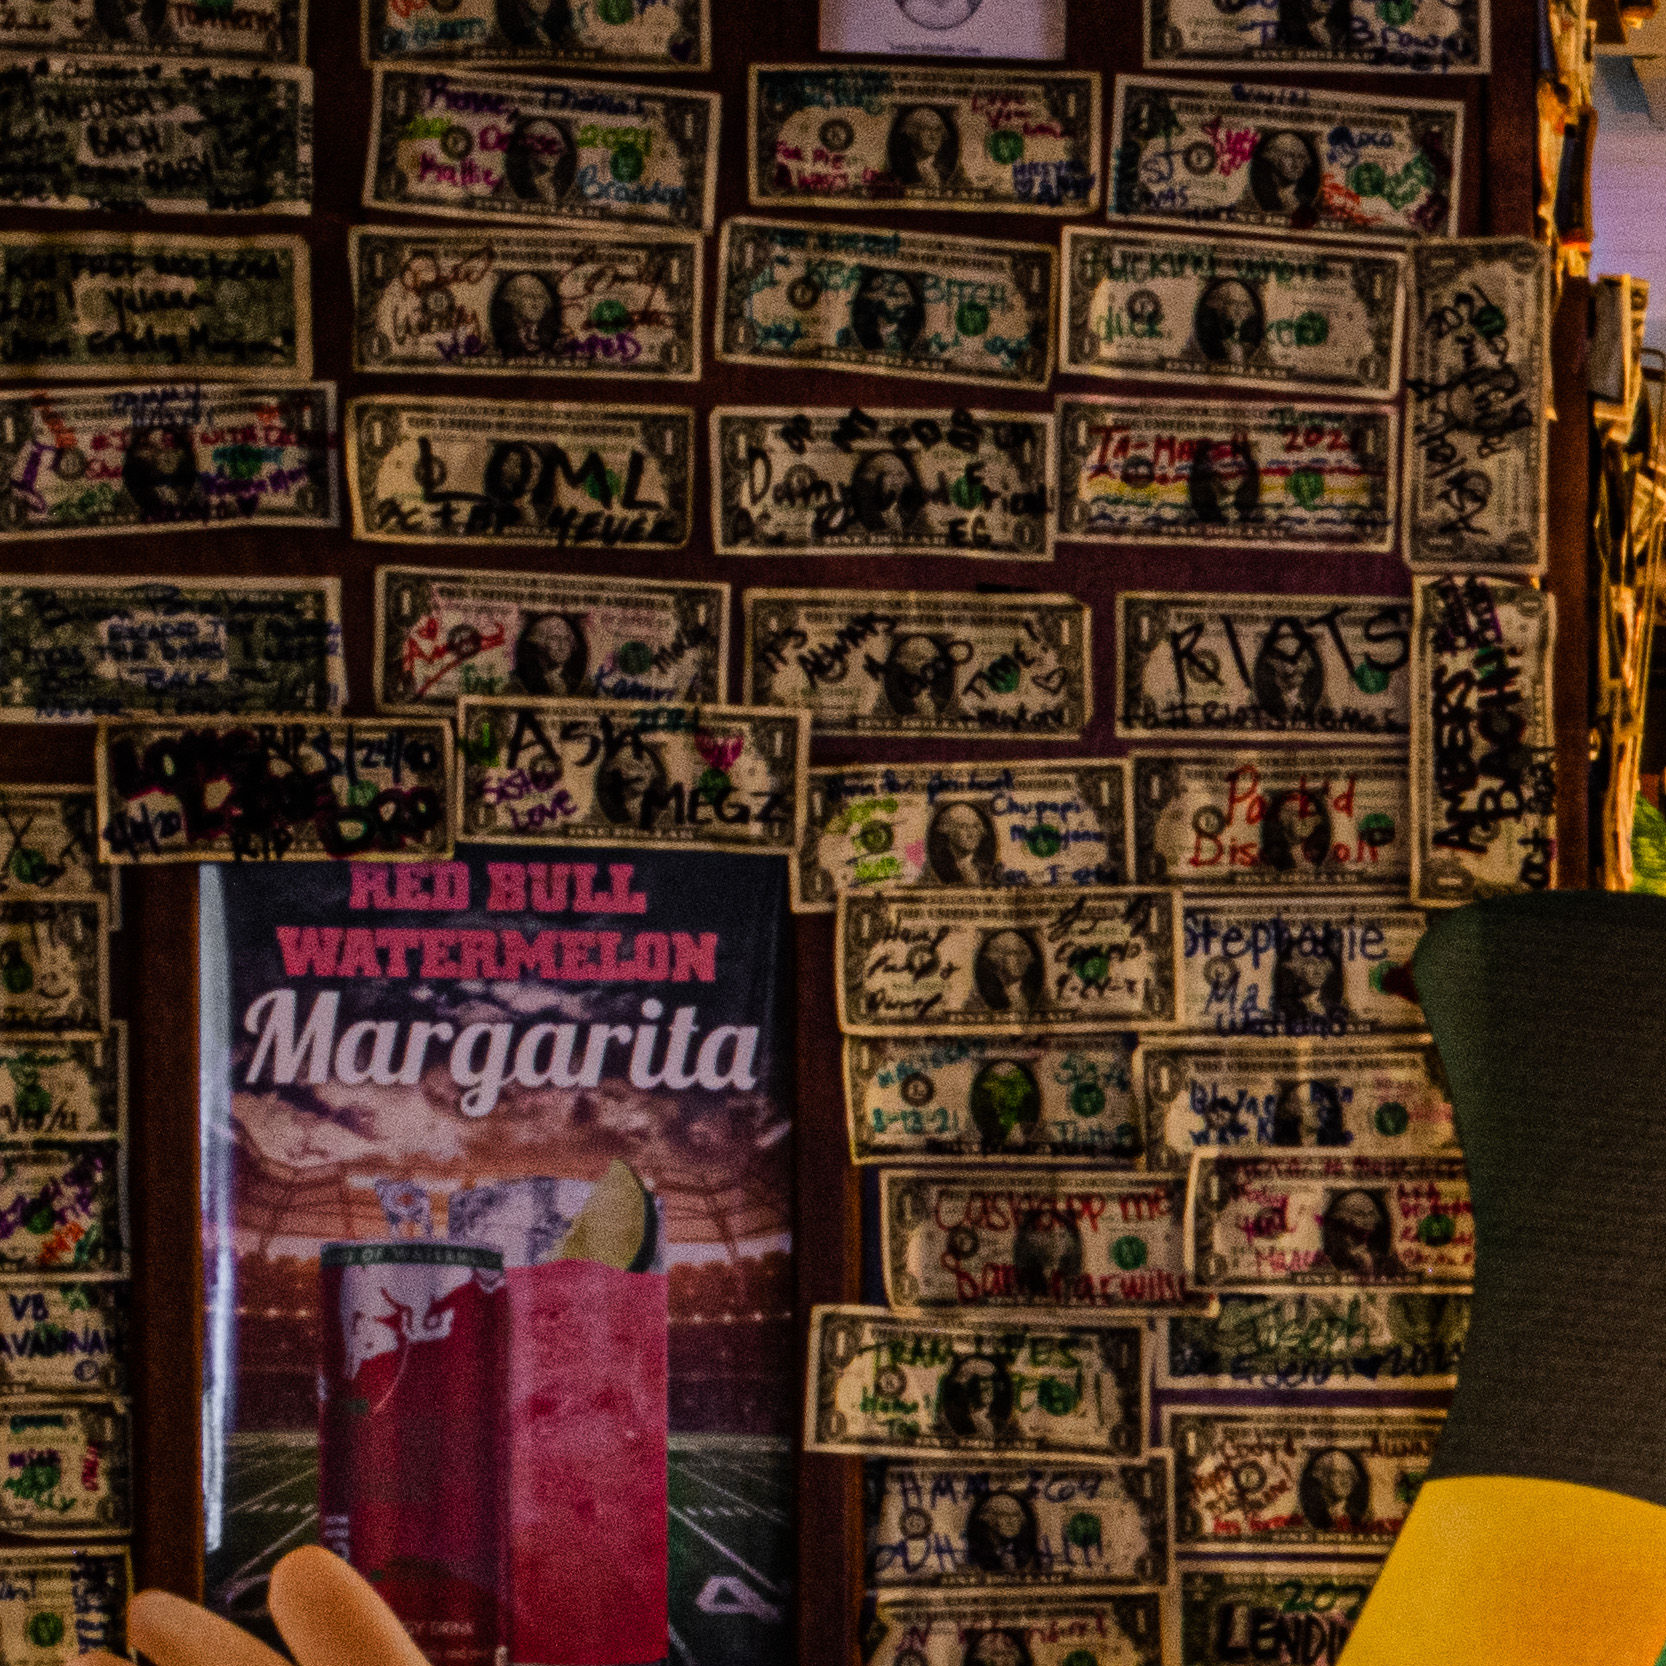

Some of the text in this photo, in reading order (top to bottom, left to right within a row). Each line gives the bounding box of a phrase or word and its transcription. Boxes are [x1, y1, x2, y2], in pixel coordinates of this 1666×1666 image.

[348, 860, 648, 915] RED BULL
[275, 925, 719, 984] WATERMELON
[243, 986, 761, 1118] Margarita
